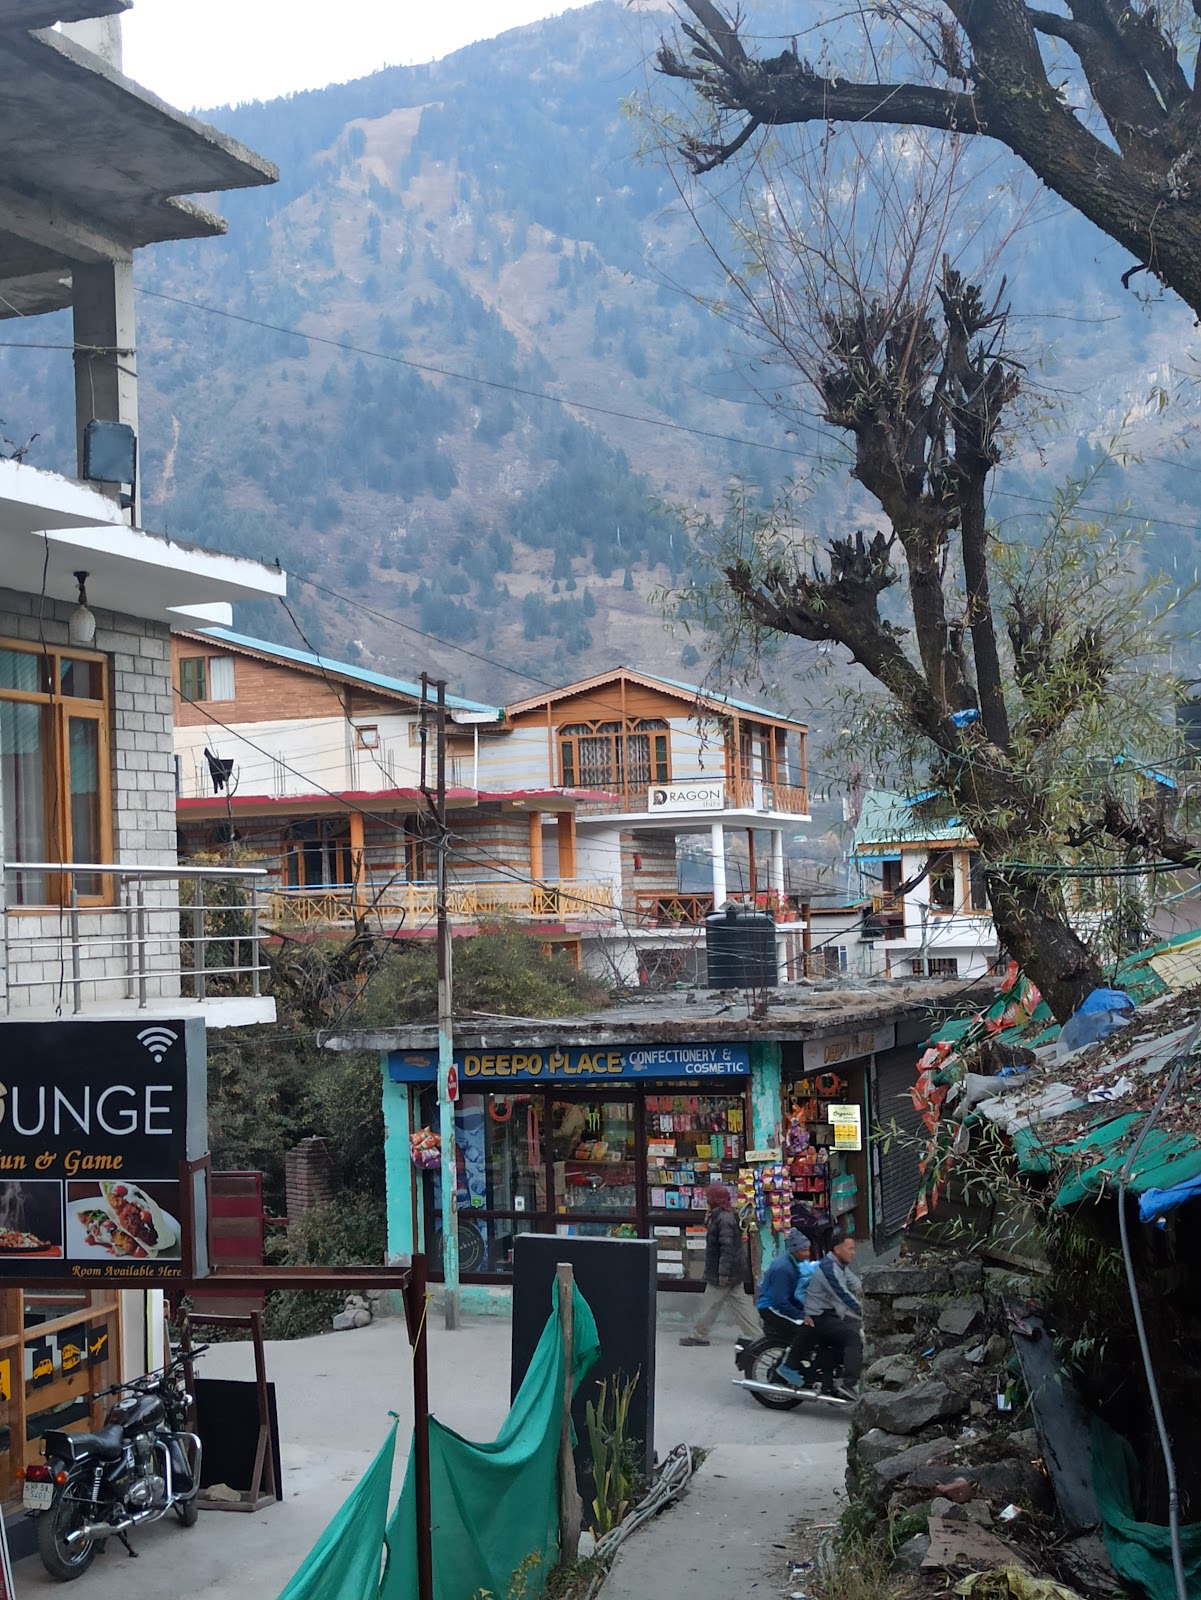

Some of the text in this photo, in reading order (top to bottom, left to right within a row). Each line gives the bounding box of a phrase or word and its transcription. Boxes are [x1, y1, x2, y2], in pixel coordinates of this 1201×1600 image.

[652, 789, 720, 805] DRAGON
[464, 1048, 732, 1076] DEEPO PLACE CONFECTIONERY &
[685, 1062, 744, 1073] COSMETIC
[0, 1083, 173, 1136] UNGE
[0, 1150, 123, 1176] un & Game
[72, 1265, 182, 1277] Room Available Here
